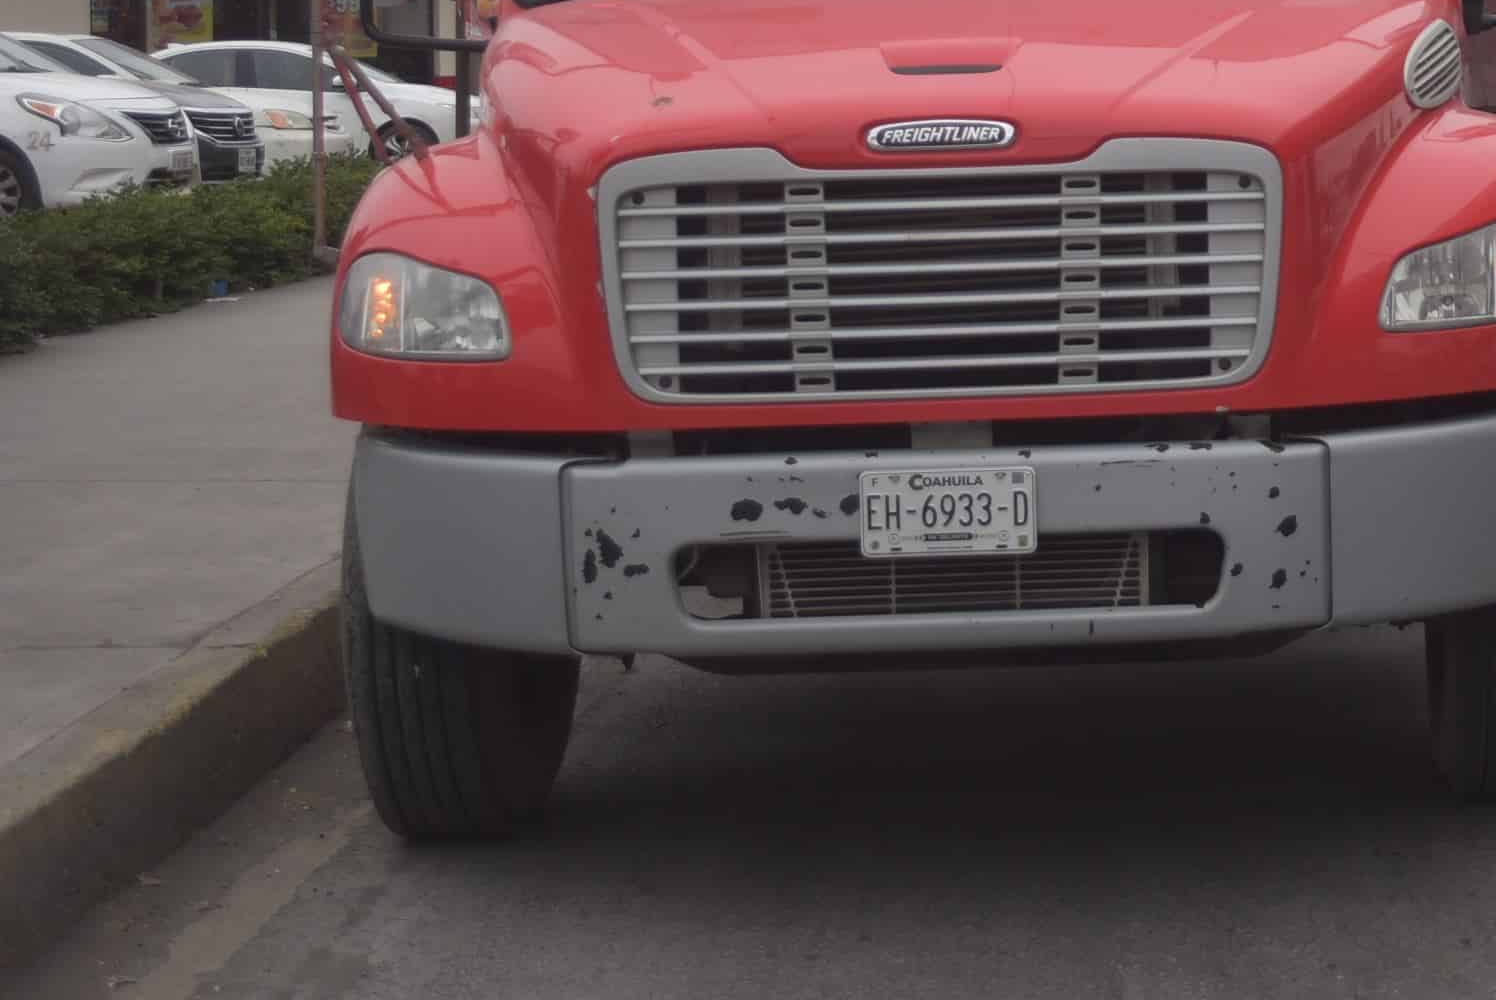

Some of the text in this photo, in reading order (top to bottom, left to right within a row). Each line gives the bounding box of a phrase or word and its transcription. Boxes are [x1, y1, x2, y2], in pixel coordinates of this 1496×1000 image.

[881, 126, 1000, 143] FREIGHTLINER
[908, 474, 984, 490] COAHUILA
[866, 490, 1029, 531] EH-6933-D
